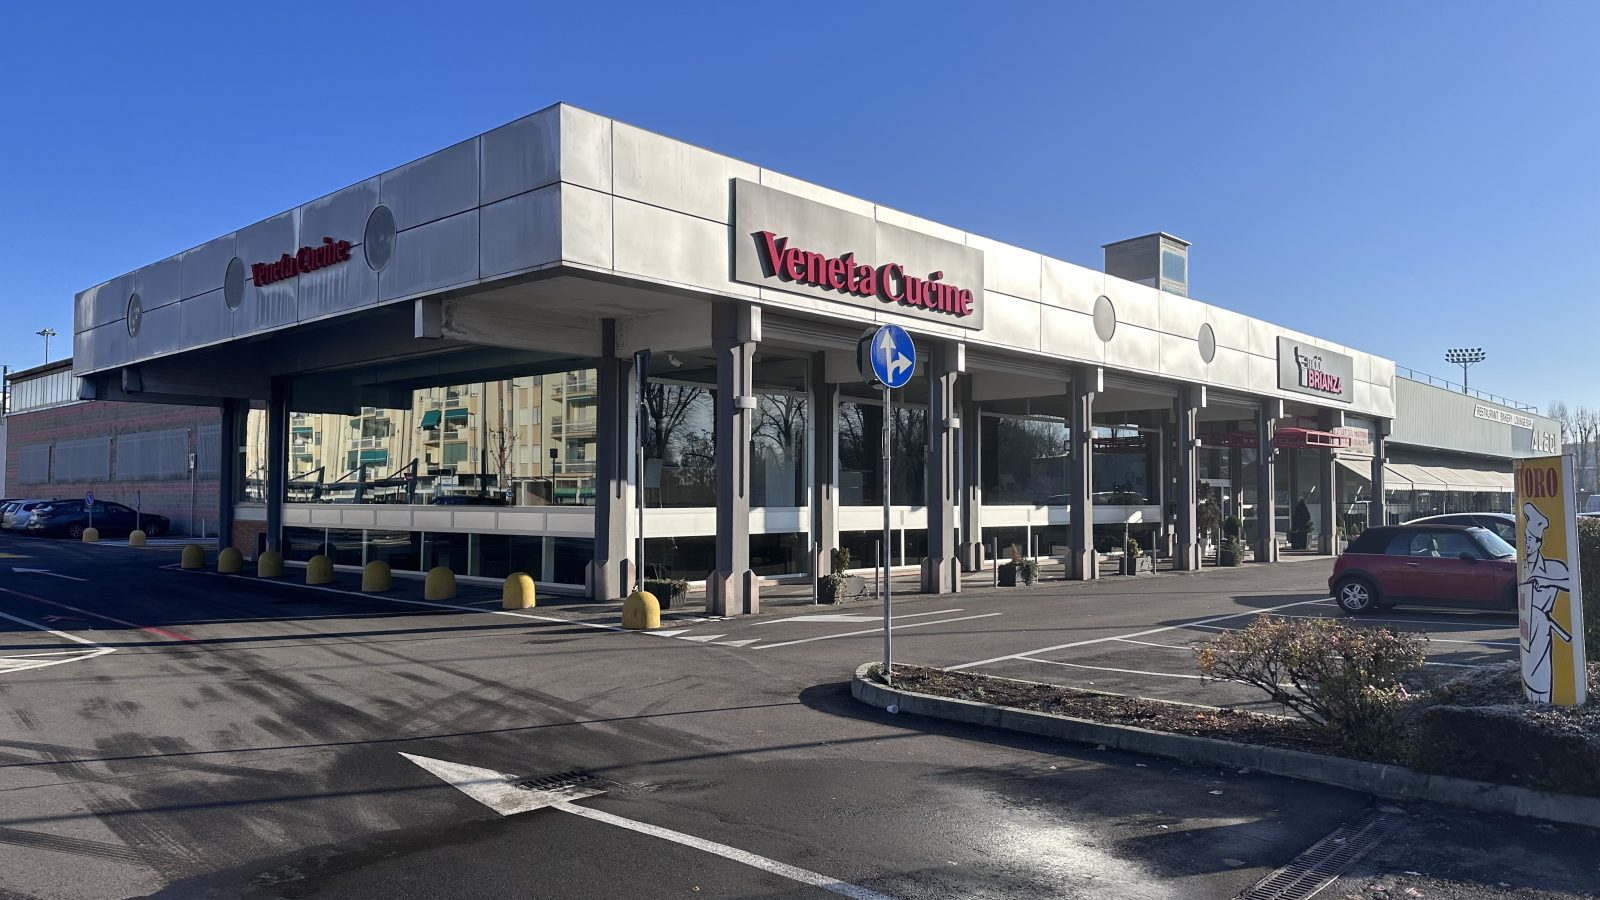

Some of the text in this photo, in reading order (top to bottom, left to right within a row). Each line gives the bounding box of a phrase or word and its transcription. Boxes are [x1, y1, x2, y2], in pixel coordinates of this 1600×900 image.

[752, 231, 974, 317] Veneta Cucine
[1308, 370, 1344, 394] BRIANZA
